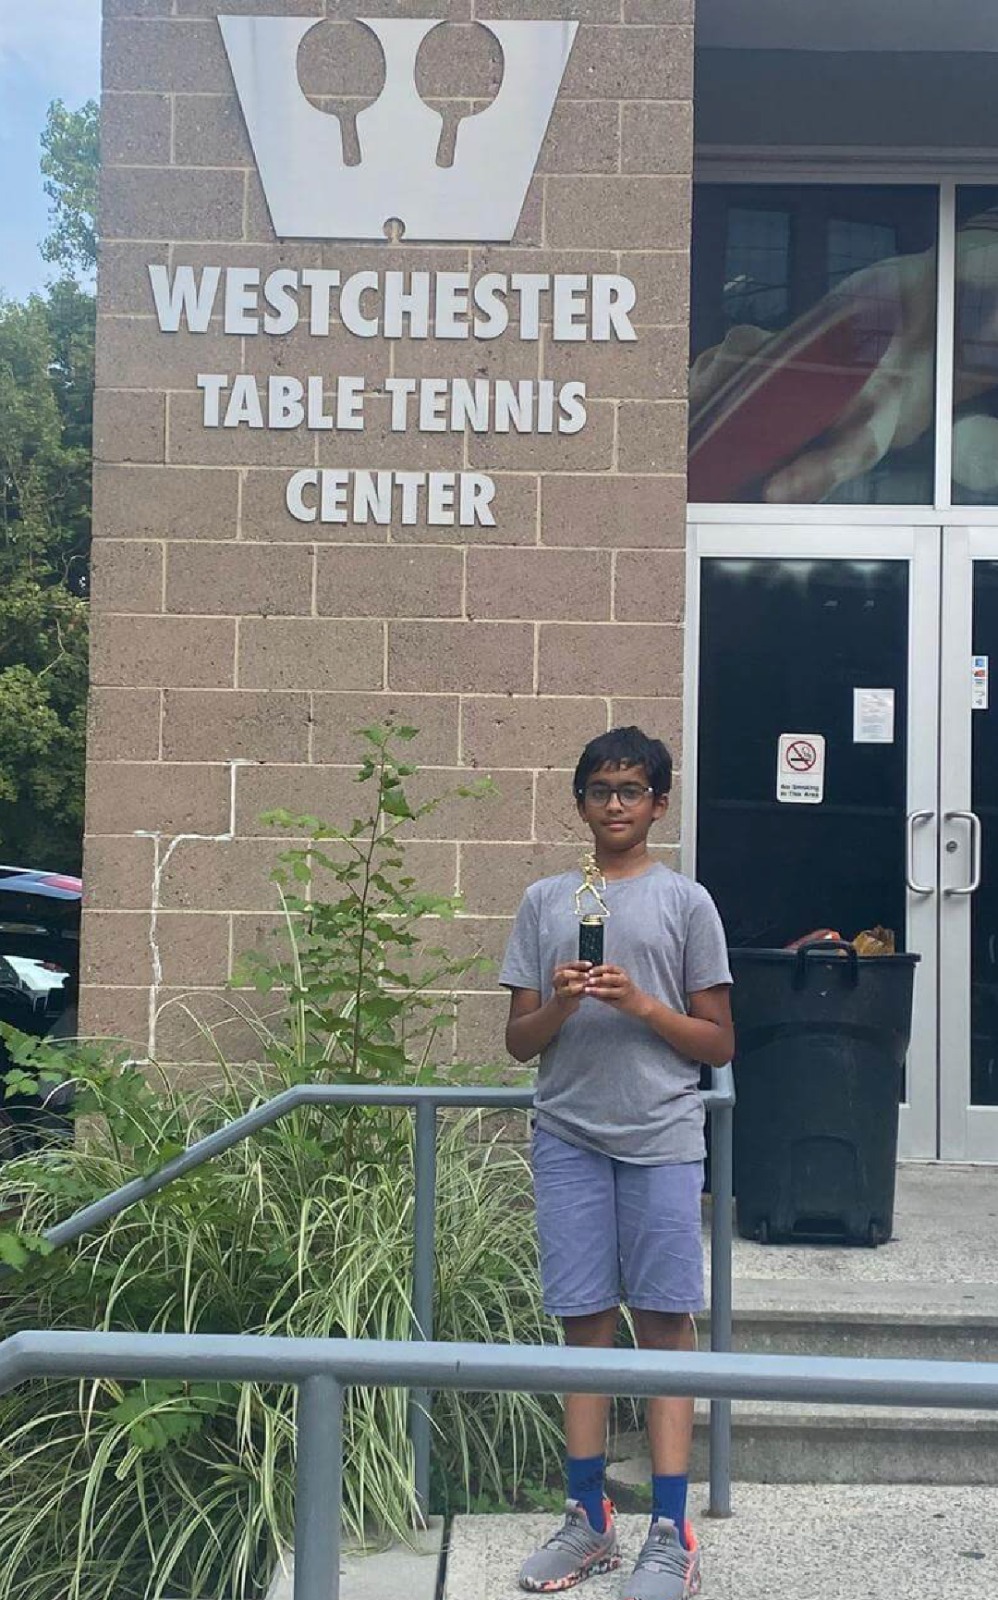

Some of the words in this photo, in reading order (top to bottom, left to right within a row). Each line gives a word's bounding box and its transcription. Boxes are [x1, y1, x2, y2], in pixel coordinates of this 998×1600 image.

[148, 264, 638, 342] WESTCHESTER
[197, 374, 366, 431] TABLE
[385, 377, 588, 434] TENNIS
[286, 469, 497, 527] CENTER
